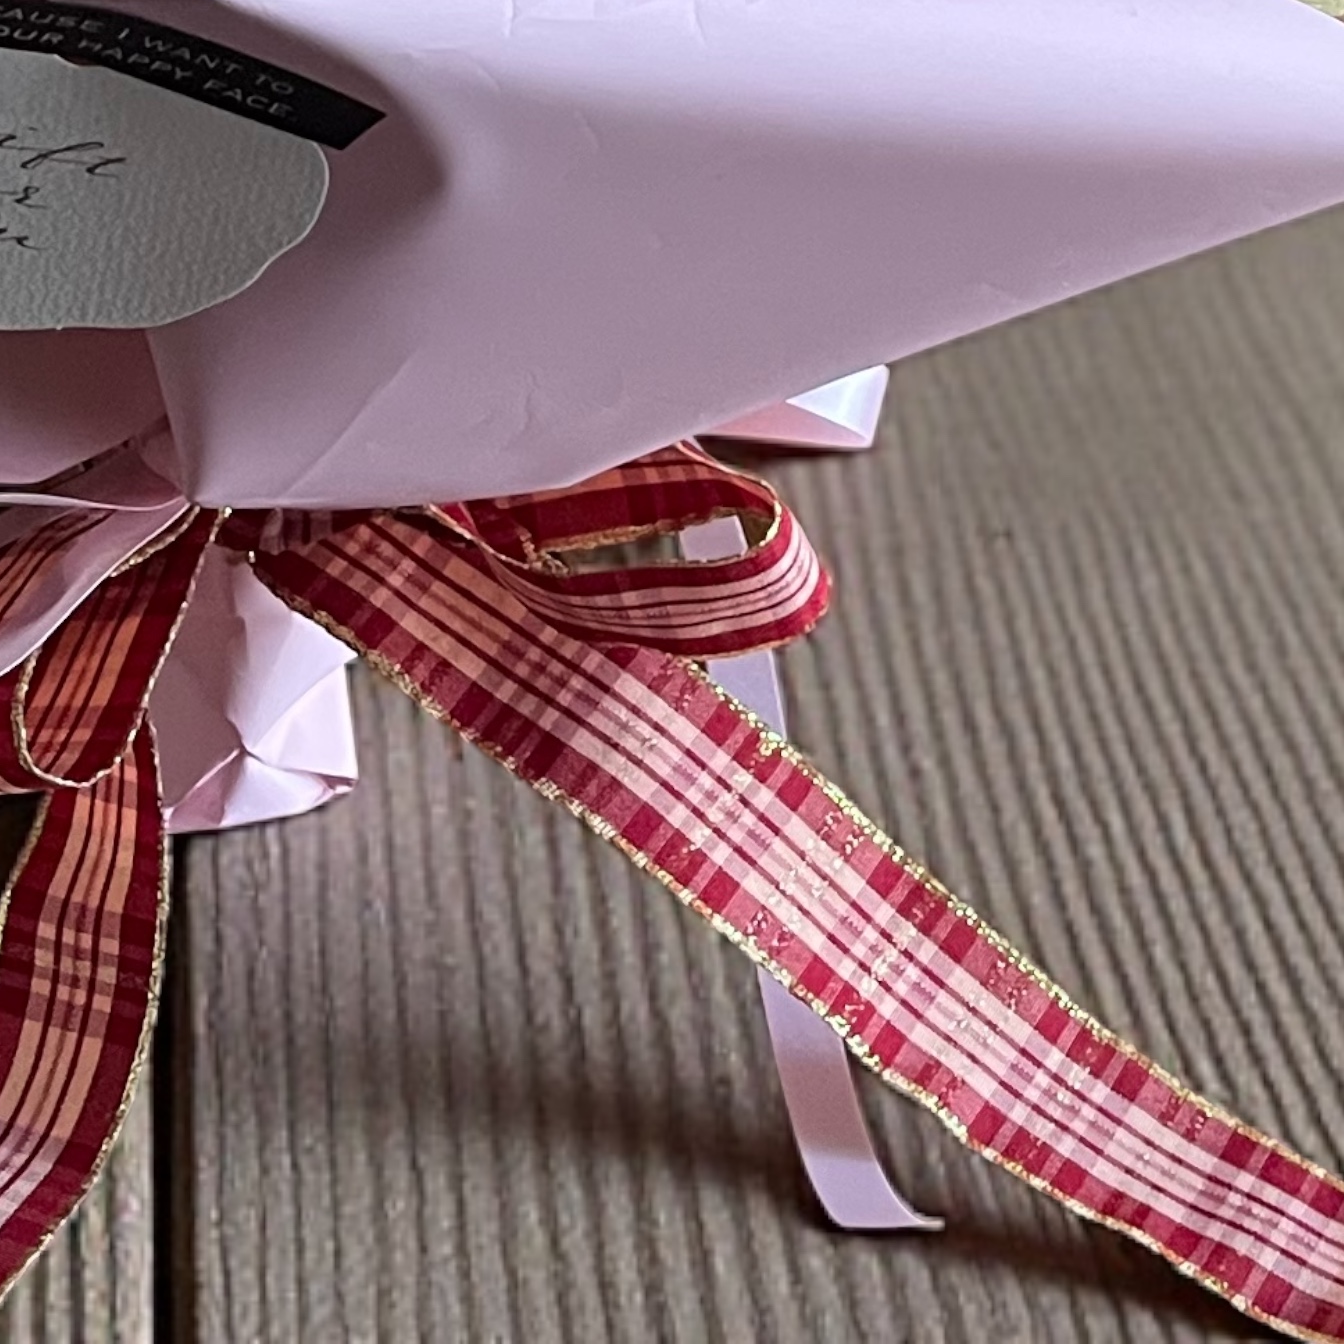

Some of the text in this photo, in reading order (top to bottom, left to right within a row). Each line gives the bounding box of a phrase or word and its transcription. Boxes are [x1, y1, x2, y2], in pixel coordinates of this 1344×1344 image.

[78, 38, 192, 79] HAPPY
[145, 36, 244, 73] WANT
[255, 73, 295, 95] TO
